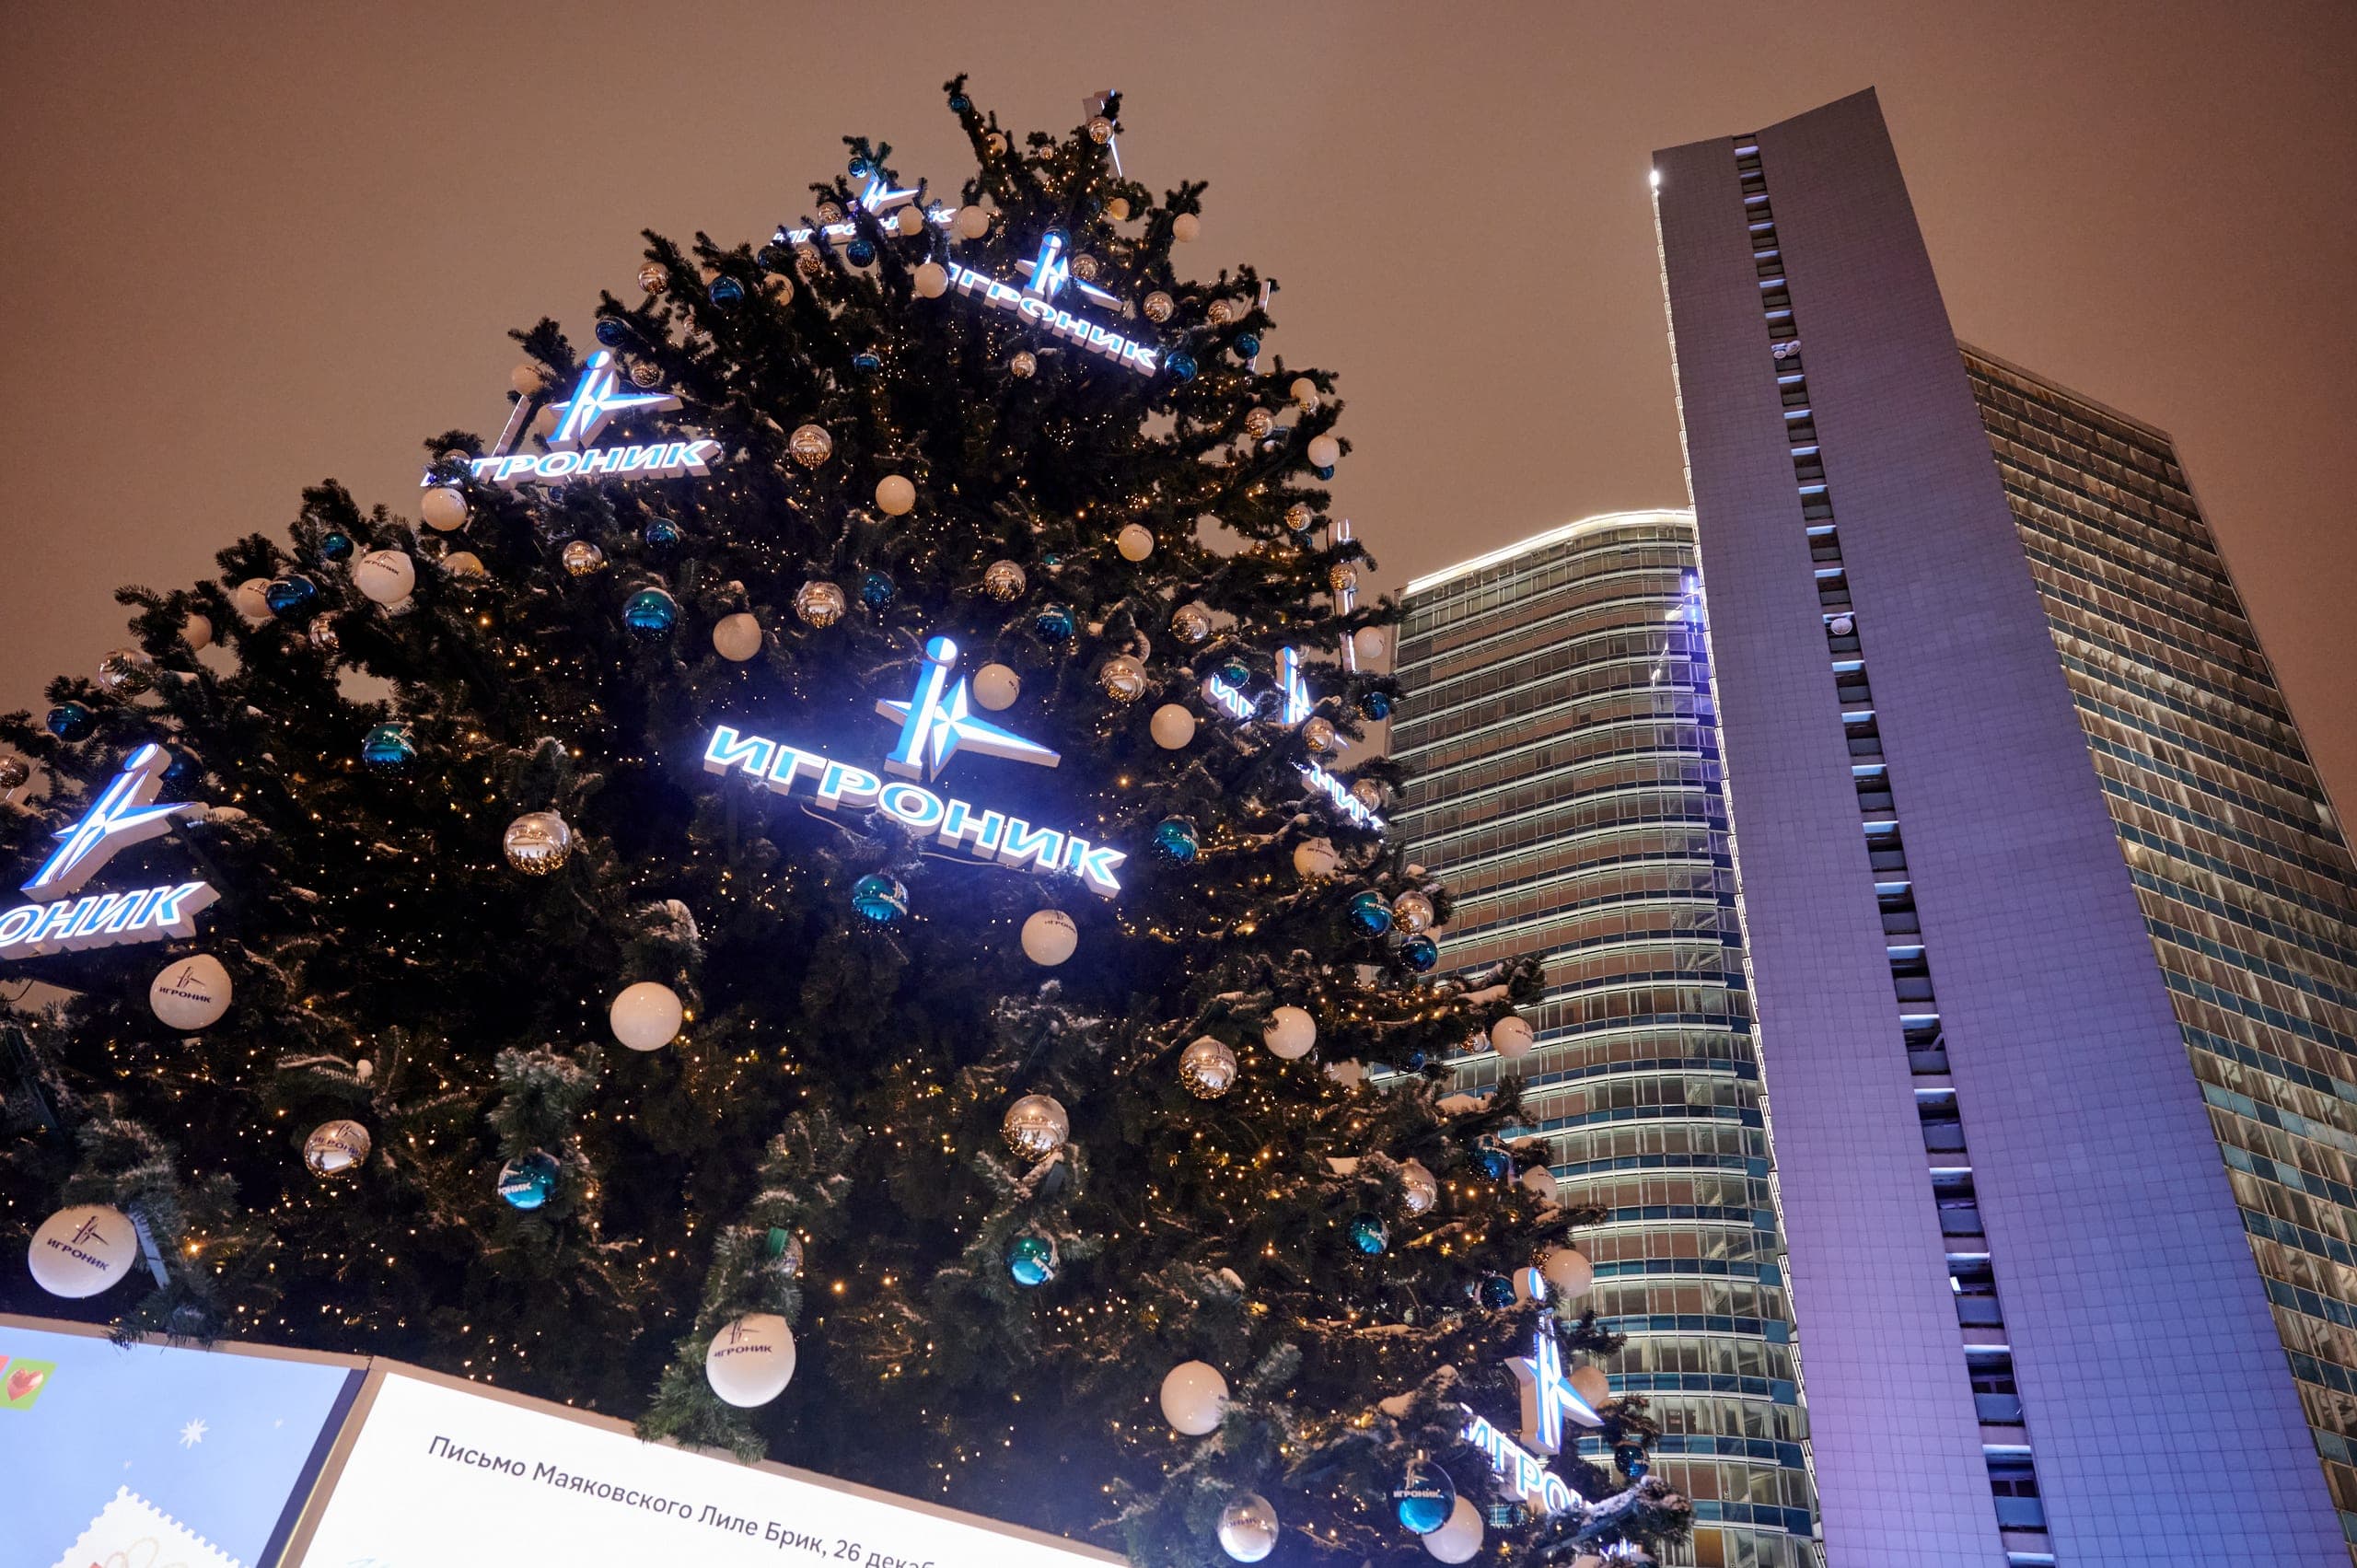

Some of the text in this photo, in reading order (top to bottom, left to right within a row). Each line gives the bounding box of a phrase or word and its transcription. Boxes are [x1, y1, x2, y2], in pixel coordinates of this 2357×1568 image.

[420, 439, 714, 486] ГРОНИК
[703, 724, 1128, 893] ИГРОНИК
[158, 986, 212, 1004] ИГРОНИК
[47, 1237, 110, 1272] ИГРОНИК
[428, 1435, 527, 1477] Письмо
[532, 1461, 693, 1520] Маяковского
[698, 1504, 759, 1537] Лиле
[764, 1521, 828, 1558] Брик,
[833, 1539, 862, 1562] 26
